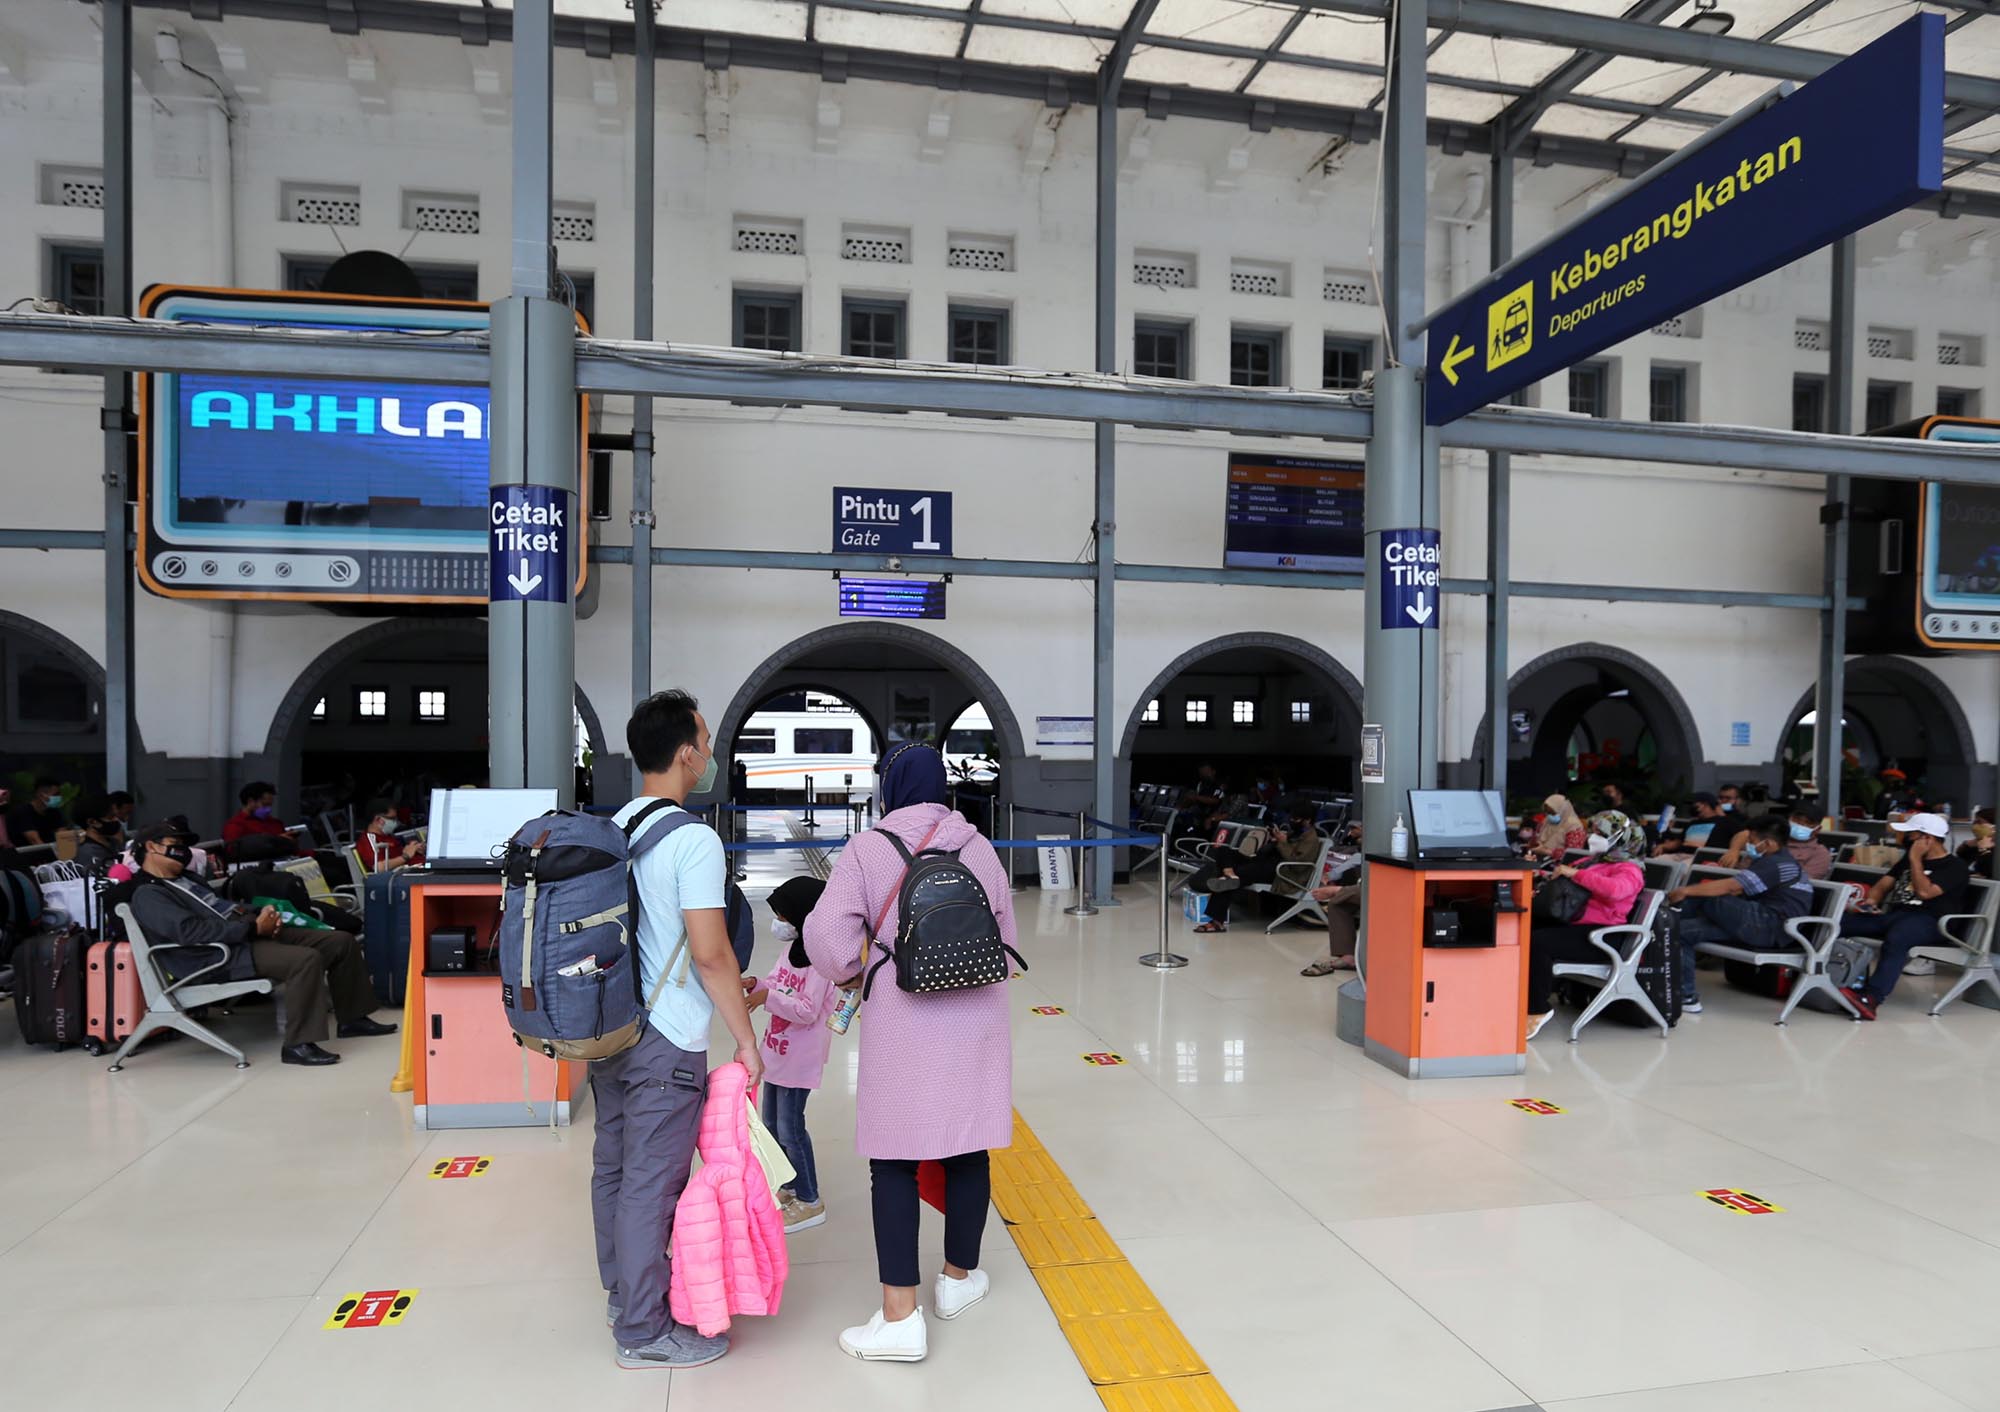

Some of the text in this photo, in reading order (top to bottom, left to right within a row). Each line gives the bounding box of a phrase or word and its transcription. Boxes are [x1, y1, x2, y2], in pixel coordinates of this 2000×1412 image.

[1550, 135, 1802, 300] Keberangkatan
[1549, 273, 1647, 338] Departures
[190, 390, 490, 440] AKHLA
[491, 501, 564, 527] Cetak
[841, 495, 941, 550] Pintu 1
[494, 527, 559, 553] Tiket
[841, 528, 880, 546] Gate
[1049, 844, 1059, 884] BRANTA
[55, 1008, 66, 1039] POLO
[365, 1301, 380, 1315] 1
